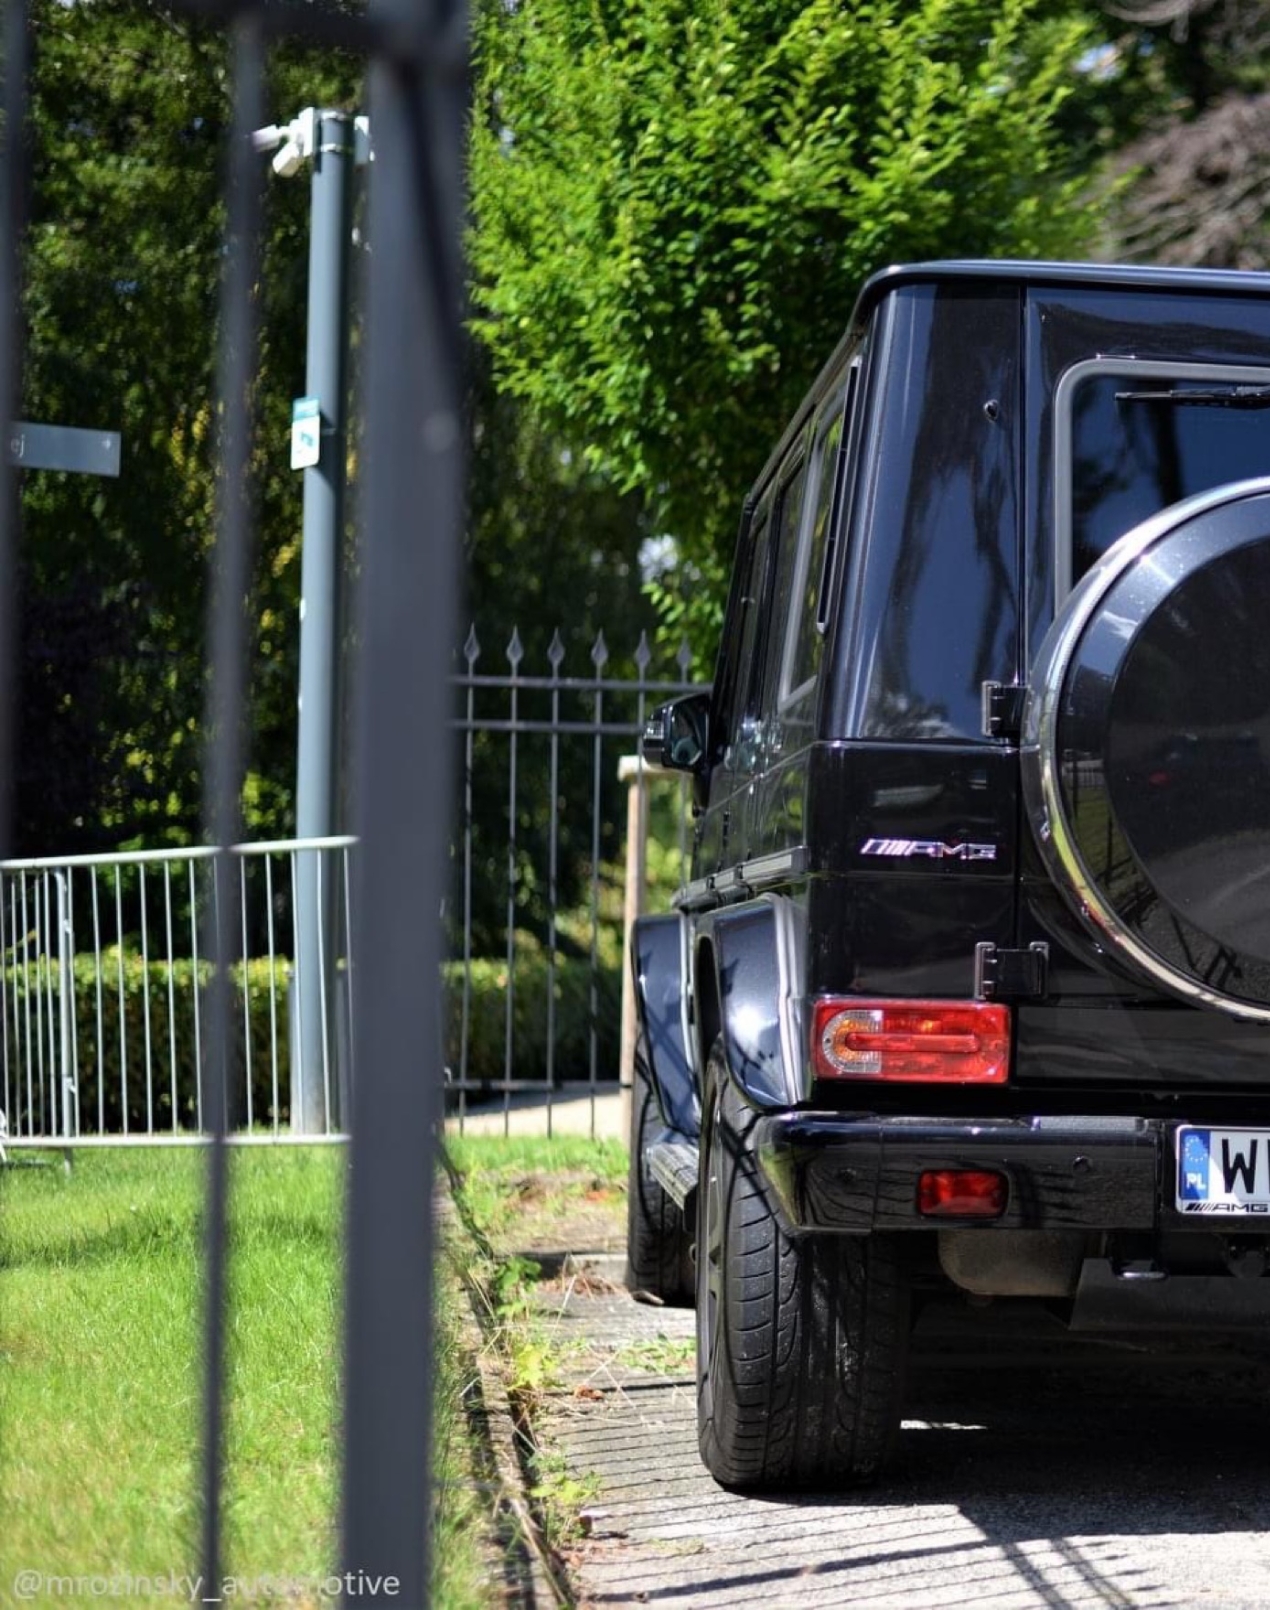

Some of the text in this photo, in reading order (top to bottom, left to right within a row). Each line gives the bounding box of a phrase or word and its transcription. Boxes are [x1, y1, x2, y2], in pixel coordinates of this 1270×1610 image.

[903, 840, 997, 860] AMG
[1186, 1172, 1206, 1190] PL
[1211, 1203, 1269, 1213] AMG
